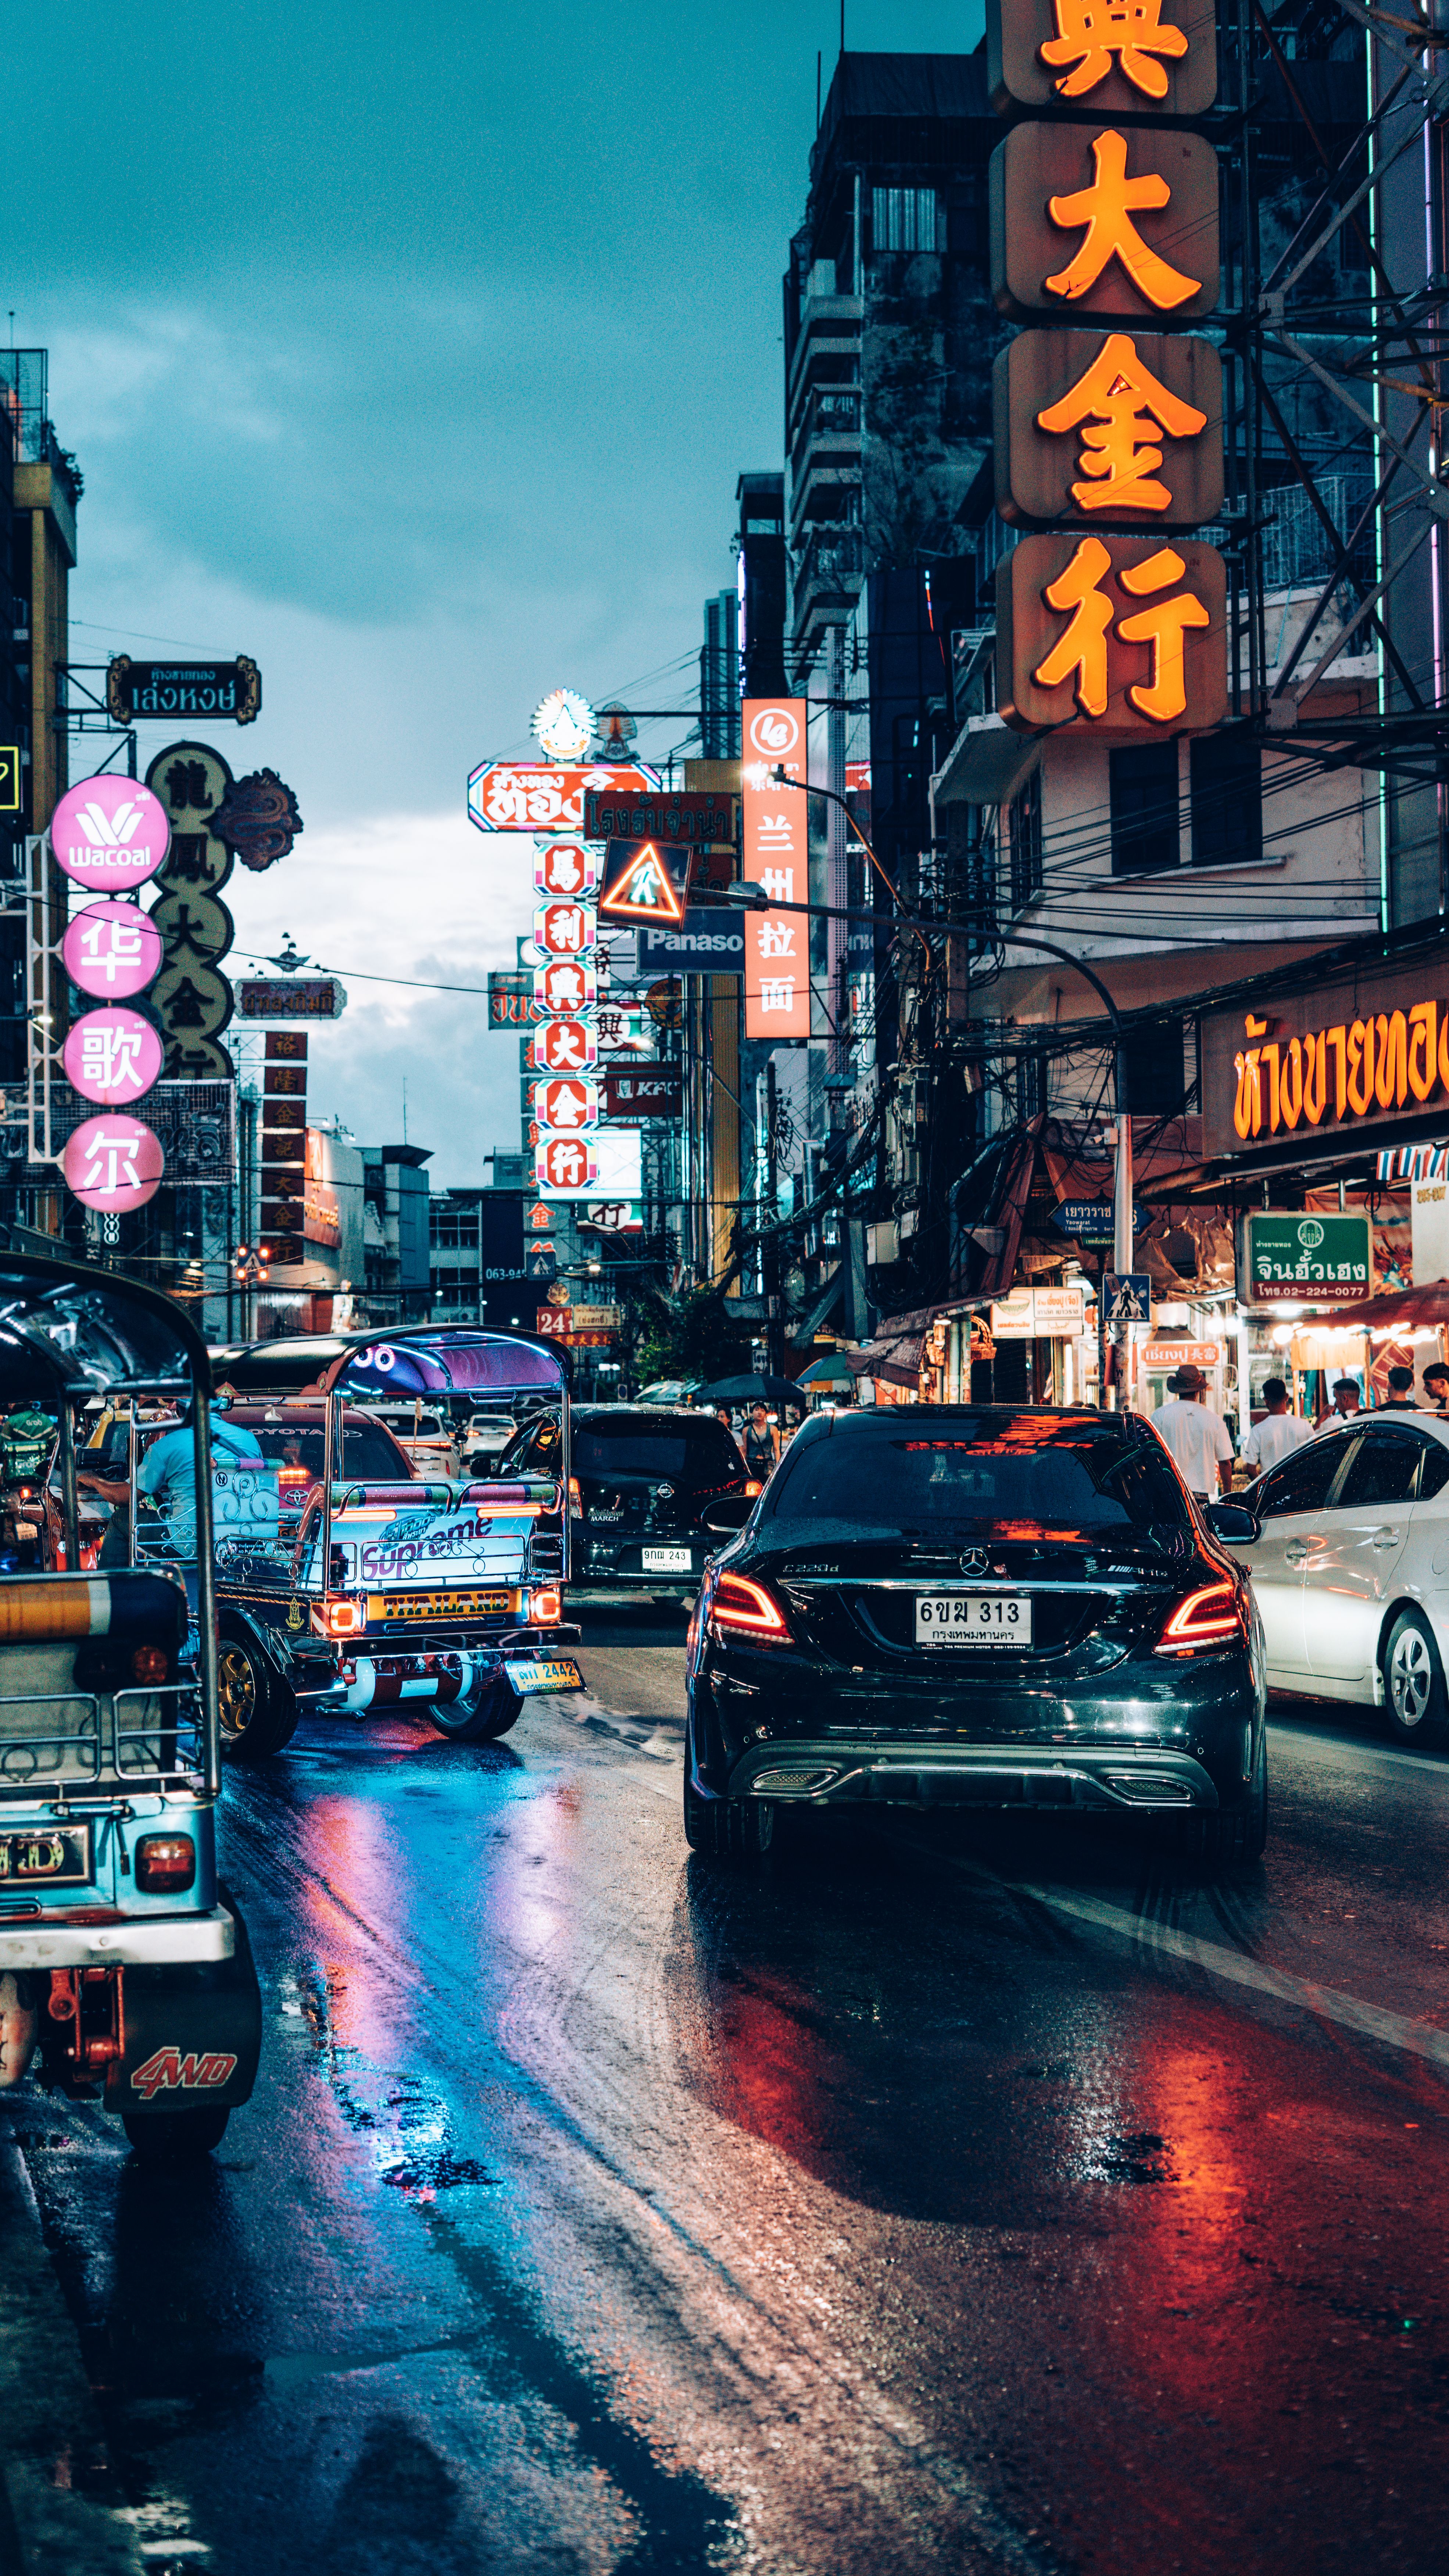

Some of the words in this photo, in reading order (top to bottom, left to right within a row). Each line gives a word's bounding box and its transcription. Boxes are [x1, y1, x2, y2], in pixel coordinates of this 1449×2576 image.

[132, 680, 236, 710] เล่งหงษ์
[587, 794, 728, 837] โรงรับจำนำ
[757, 815, 796, 1013] 兰州拉面
[81, 919, 144, 1195] 华歌尔
[1065, 1206, 1111, 1217] เยาวราช
[1256, 1249, 1366, 1280] จินฮั้วเฮง
[363, 1517, 493, 1580] Supreme
[669, 1551, 686, 1560] 243
[383, 1592, 509, 1616] THAILAND
[980, 1602, 1019, 1623] 313
[932, 1631, 1015, 1642] กรุงเทพมหานคร
[542, 1663, 575, 1678] 2442
[130, 2046, 238, 2100] 4WD
